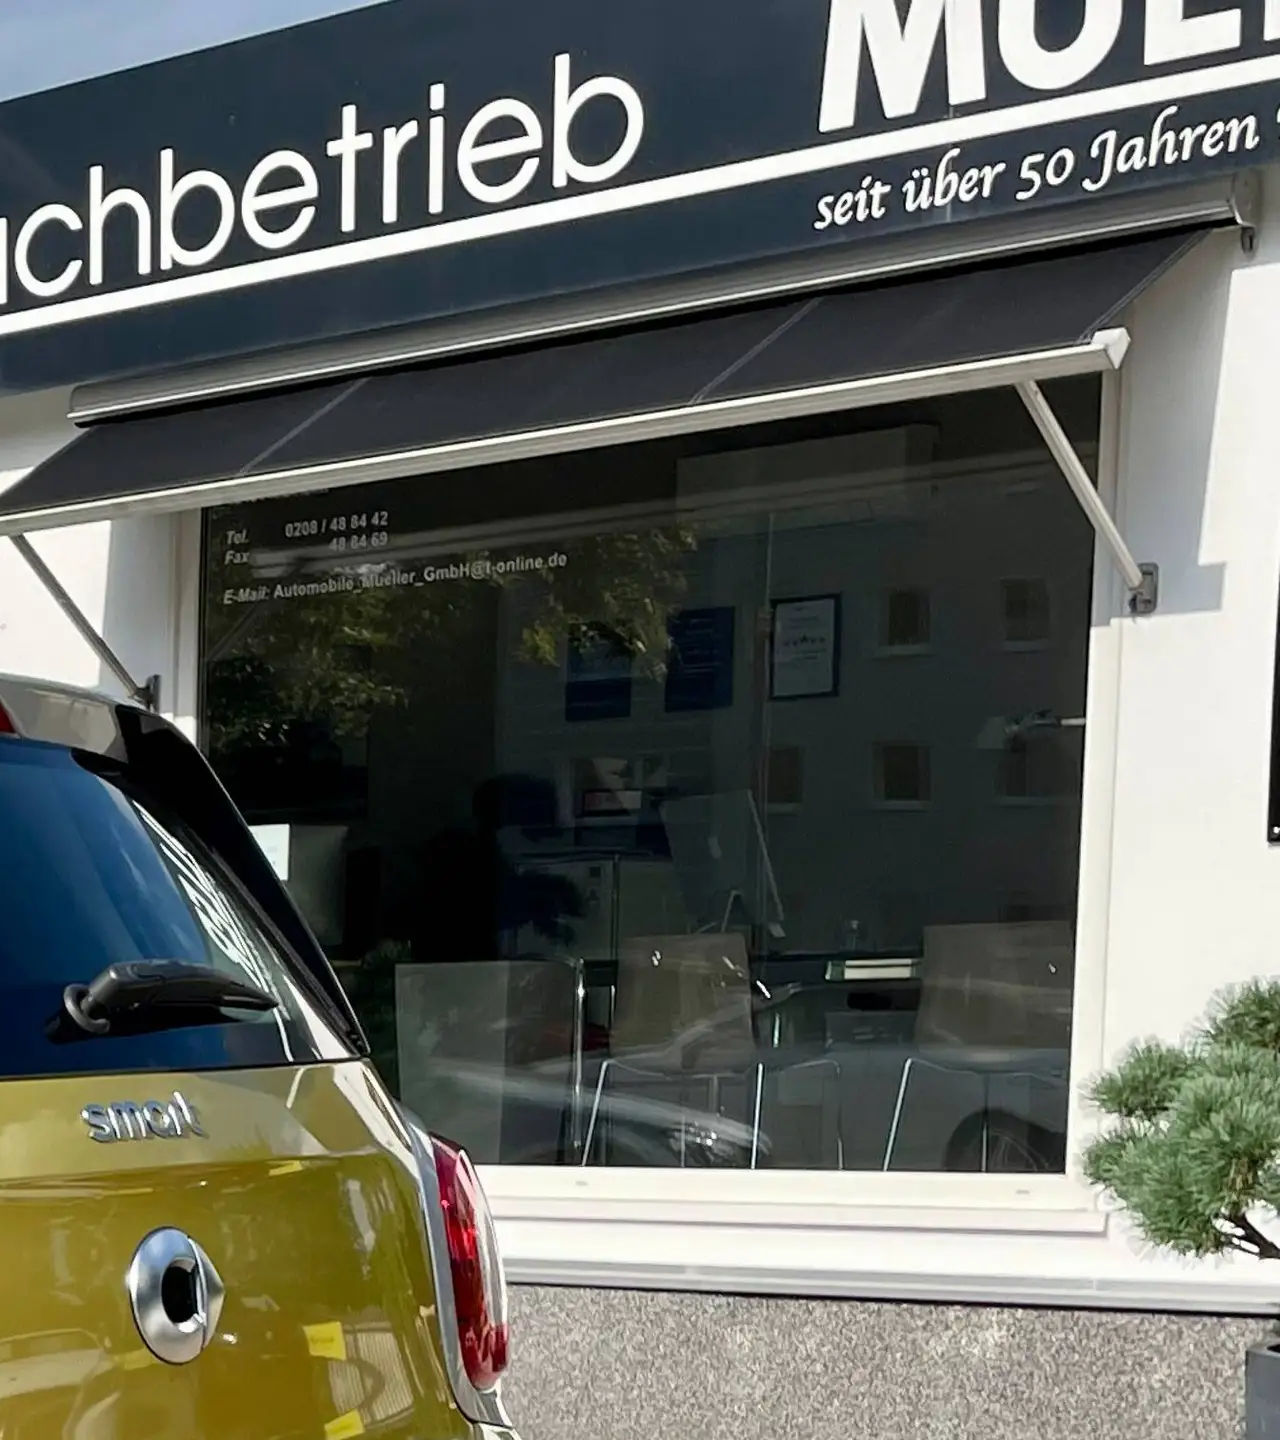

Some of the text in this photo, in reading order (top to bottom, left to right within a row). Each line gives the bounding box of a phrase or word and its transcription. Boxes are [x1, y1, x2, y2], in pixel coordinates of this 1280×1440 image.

[813, 105, 1260, 231] seit über 50 Jahren
[284, 519, 318, 539] 0208
[328, 515, 347, 532] 48
[349, 512, 368, 530] 84
[370, 510, 389, 527] 42
[224, 550, 250, 566] Fax
[370, 531, 389, 547] 69
